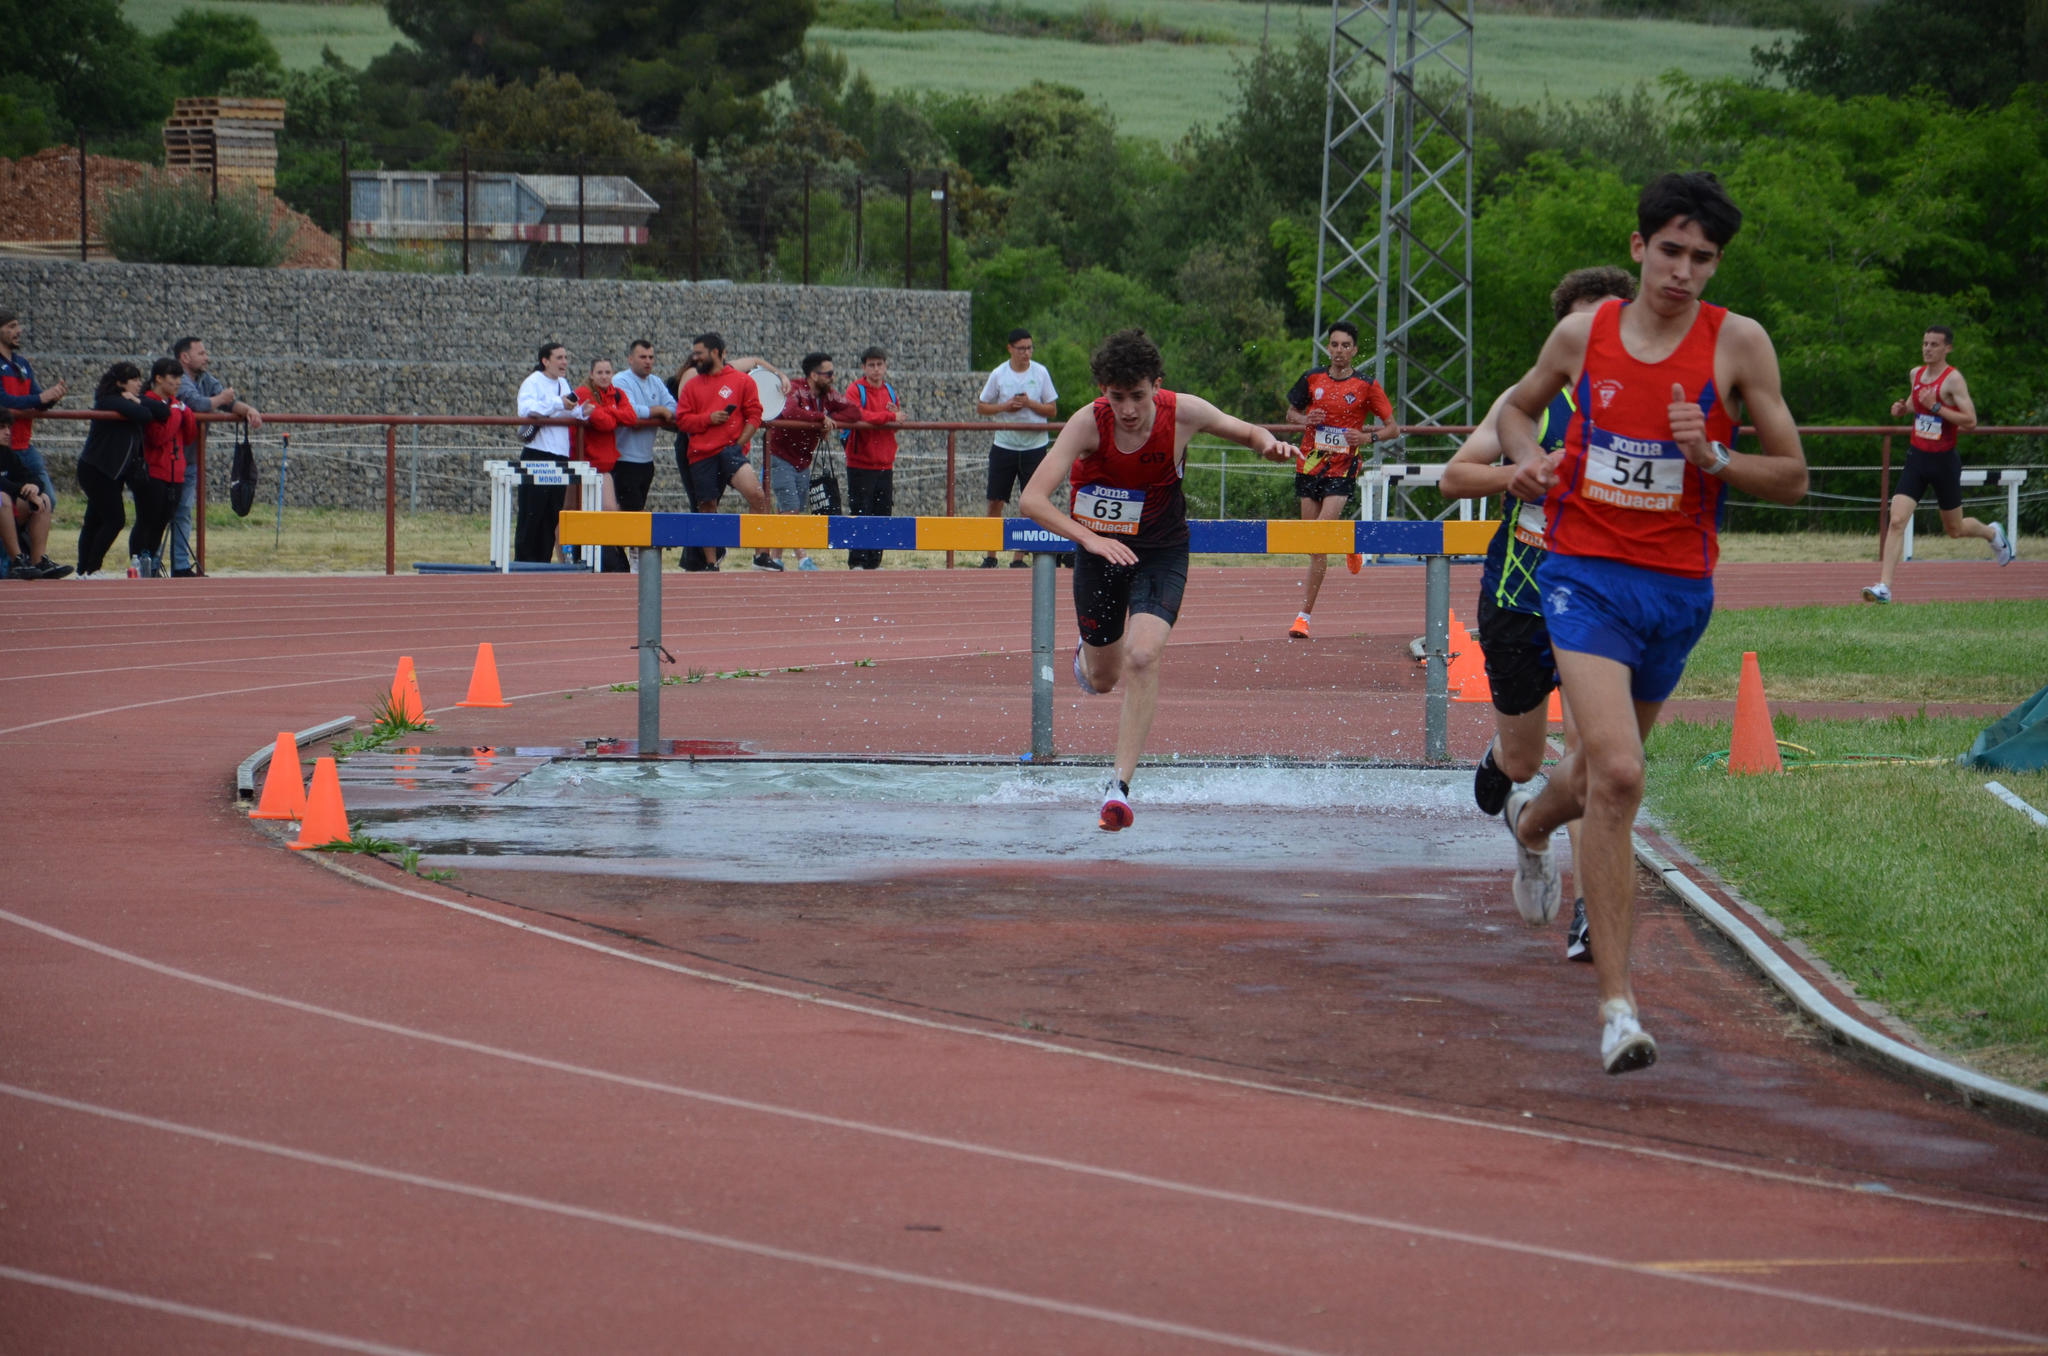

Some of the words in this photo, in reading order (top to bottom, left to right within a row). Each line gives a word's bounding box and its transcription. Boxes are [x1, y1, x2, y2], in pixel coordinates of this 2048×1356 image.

[1324, 433, 1340, 446] 66
[1609, 435, 1664, 456] Joma
[539, 476, 562, 484] MONDO
[1612, 455, 1655, 490] 54
[1092, 485, 1130, 500] Joma
[1588, 485, 1675, 511] mutuacat
[1093, 498, 1123, 520] 63
